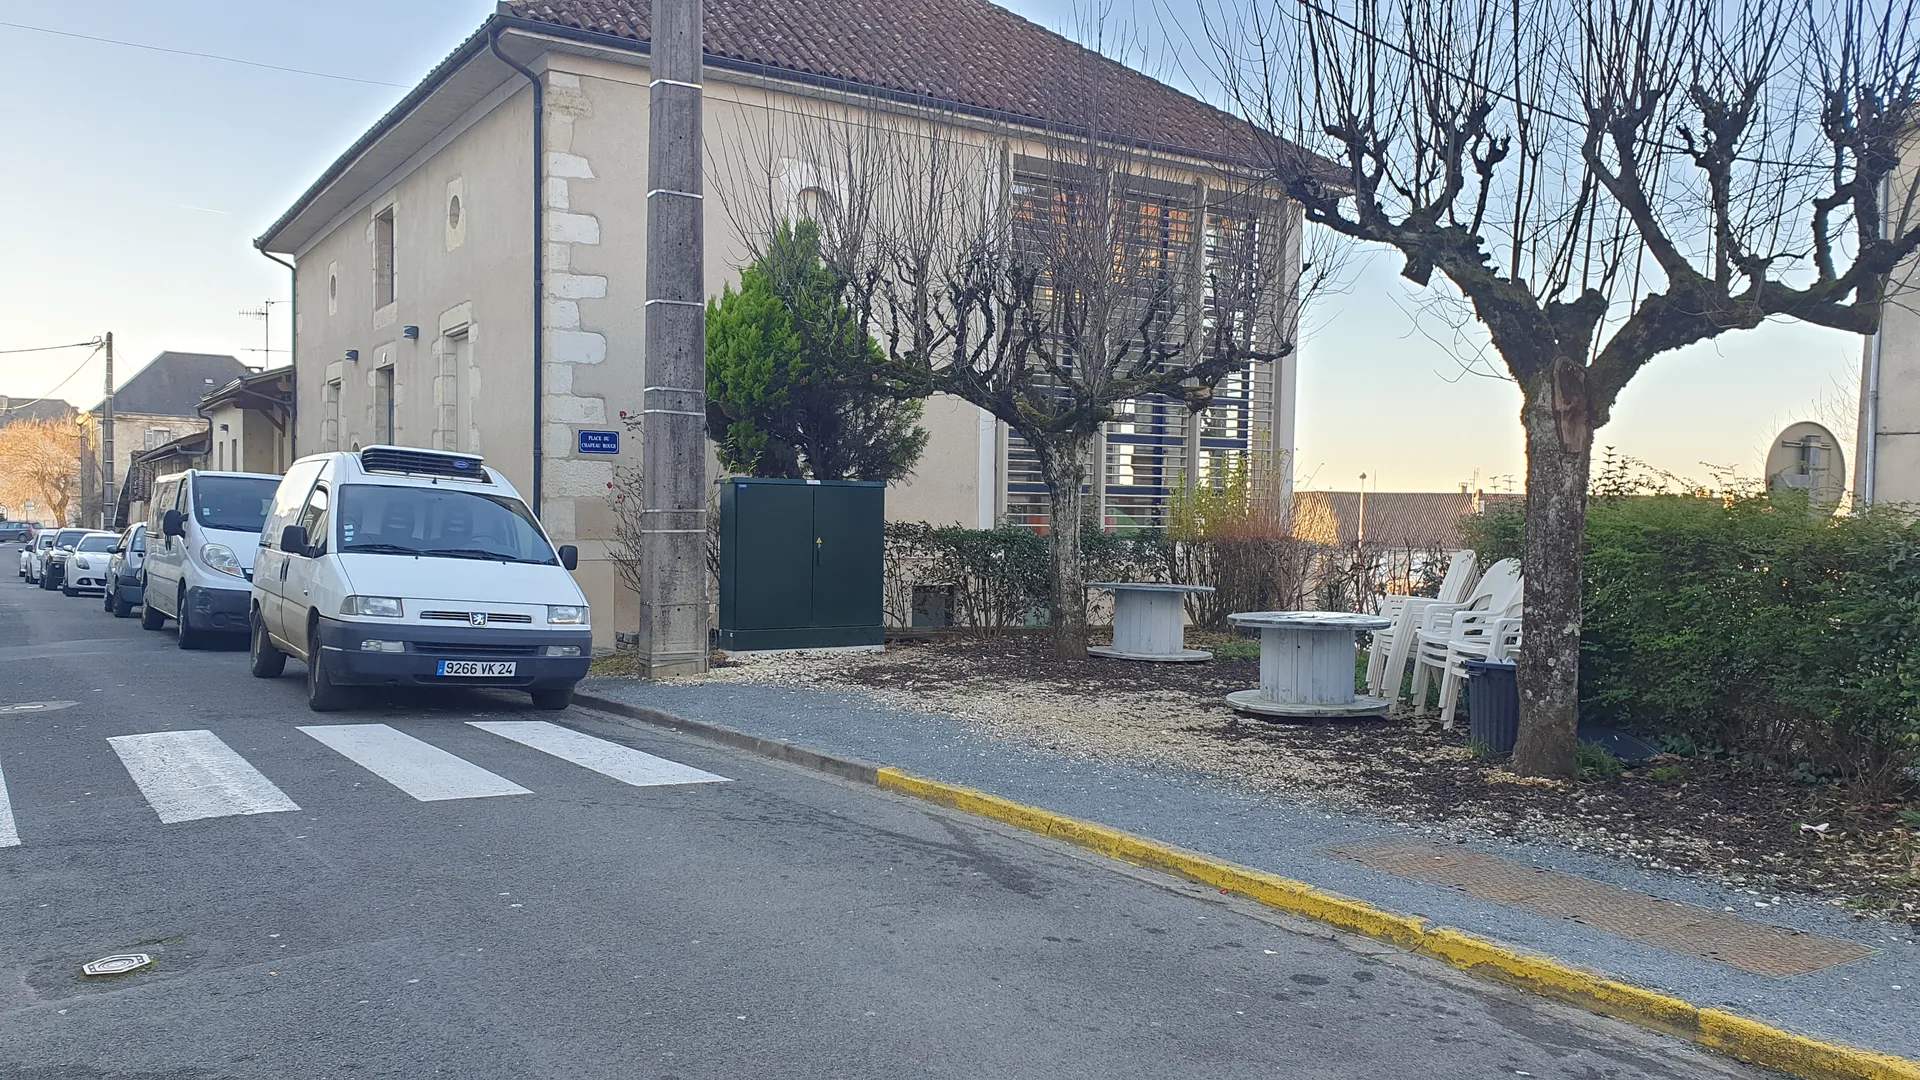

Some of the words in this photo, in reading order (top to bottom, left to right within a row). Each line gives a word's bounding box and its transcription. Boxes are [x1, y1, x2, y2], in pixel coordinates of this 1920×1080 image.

[446, 662, 478, 675] 9266
[481, 663, 496, 675] VK
[498, 663, 513, 675] 24
